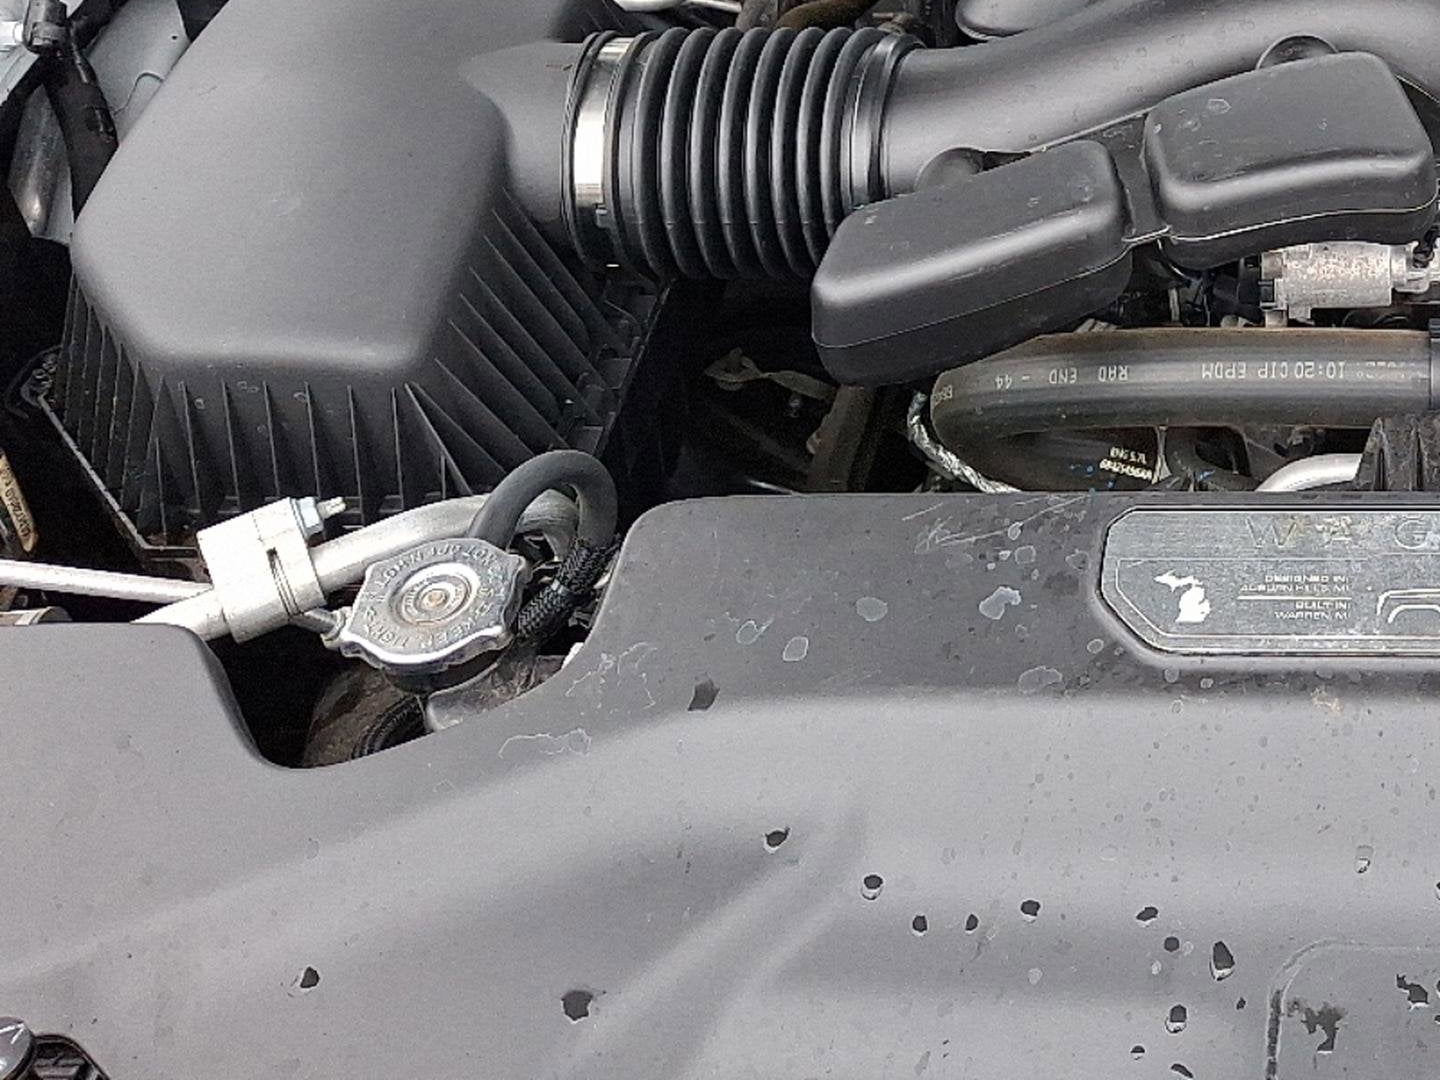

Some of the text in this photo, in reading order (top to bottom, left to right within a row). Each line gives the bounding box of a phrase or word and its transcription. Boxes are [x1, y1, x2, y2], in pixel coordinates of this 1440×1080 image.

[1048, 366, 1079, 385] END
[1098, 363, 1129, 383] RAD
[1257, 361, 1289, 379] CIP
[1239, 583, 1293, 593] AUBURN
[1333, 584, 1350, 593] MI
[1295, 601, 1333, 610] BUILT
[1334, 611, 1351, 620] MI
